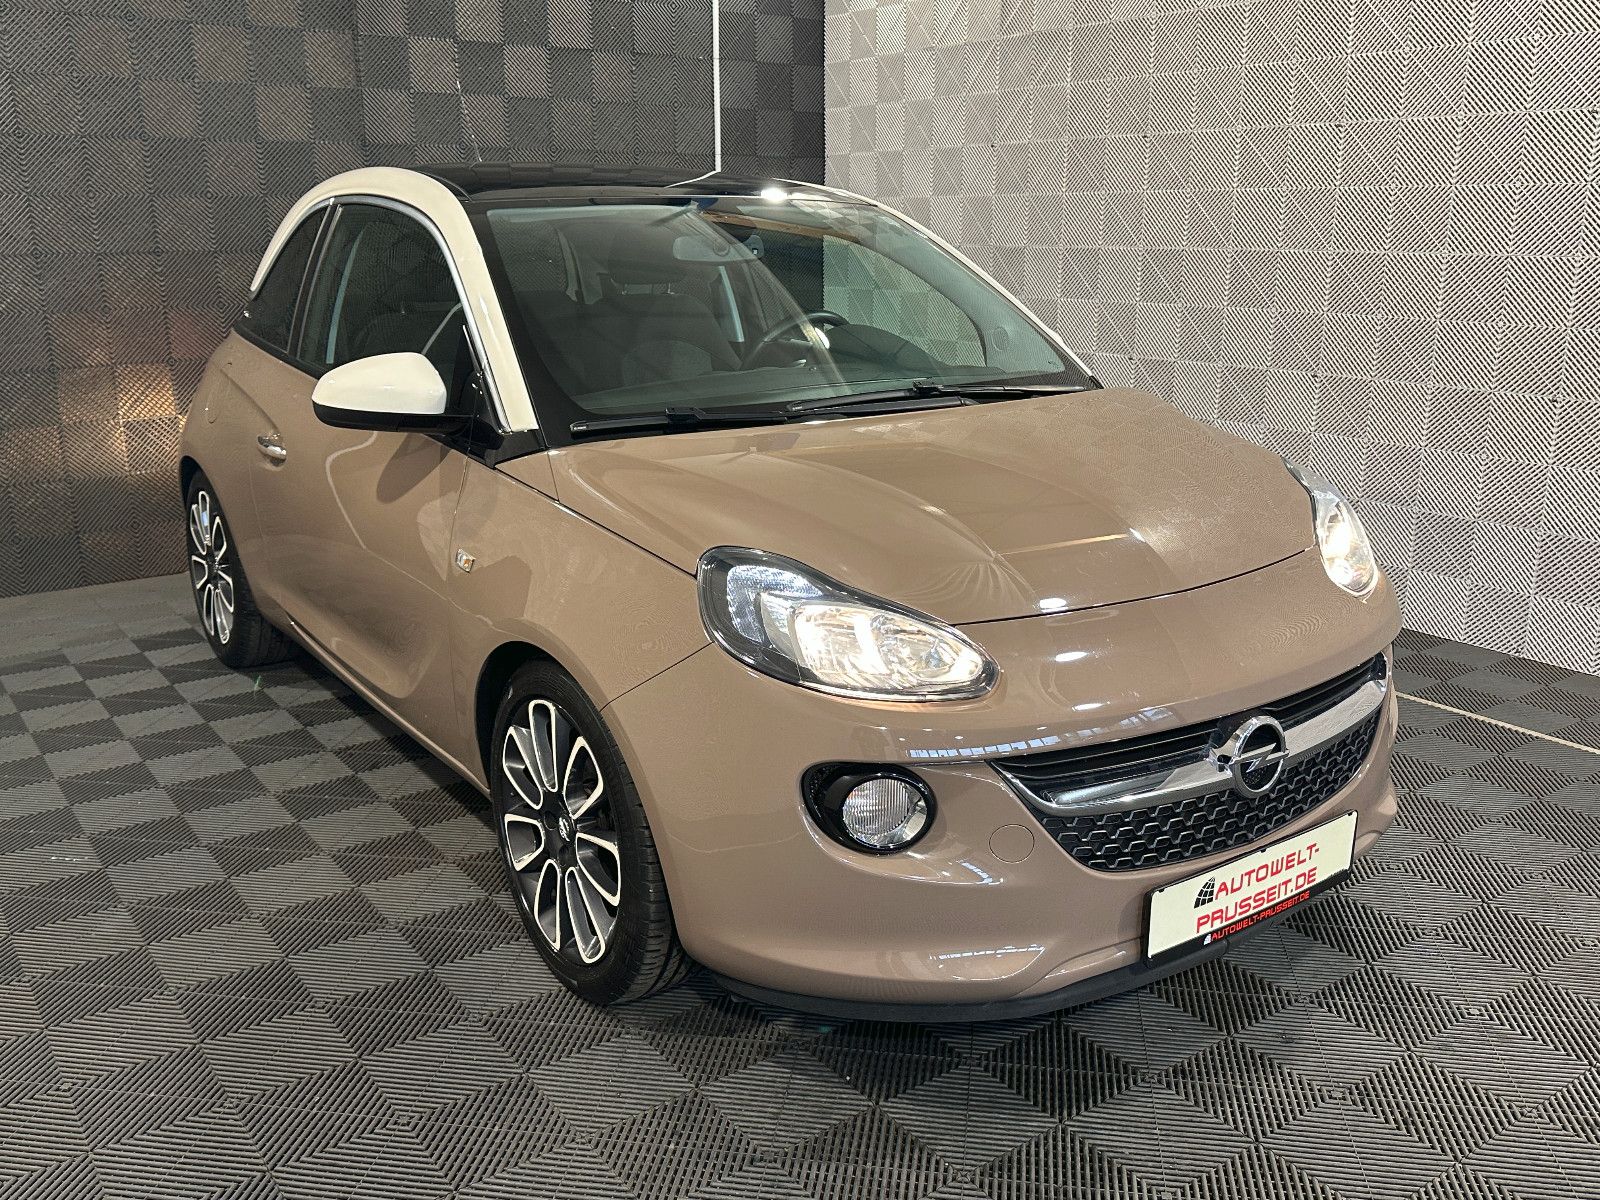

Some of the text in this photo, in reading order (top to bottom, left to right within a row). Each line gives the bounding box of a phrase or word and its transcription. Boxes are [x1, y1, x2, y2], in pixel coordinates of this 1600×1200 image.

[1196, 867, 1318, 933] PRUSSEIT.DE
[1214, 843, 1320, 900] AUTOWELT-
[1211, 891, 1310, 942] AUTOWELT-PRUSSEIT.DE
